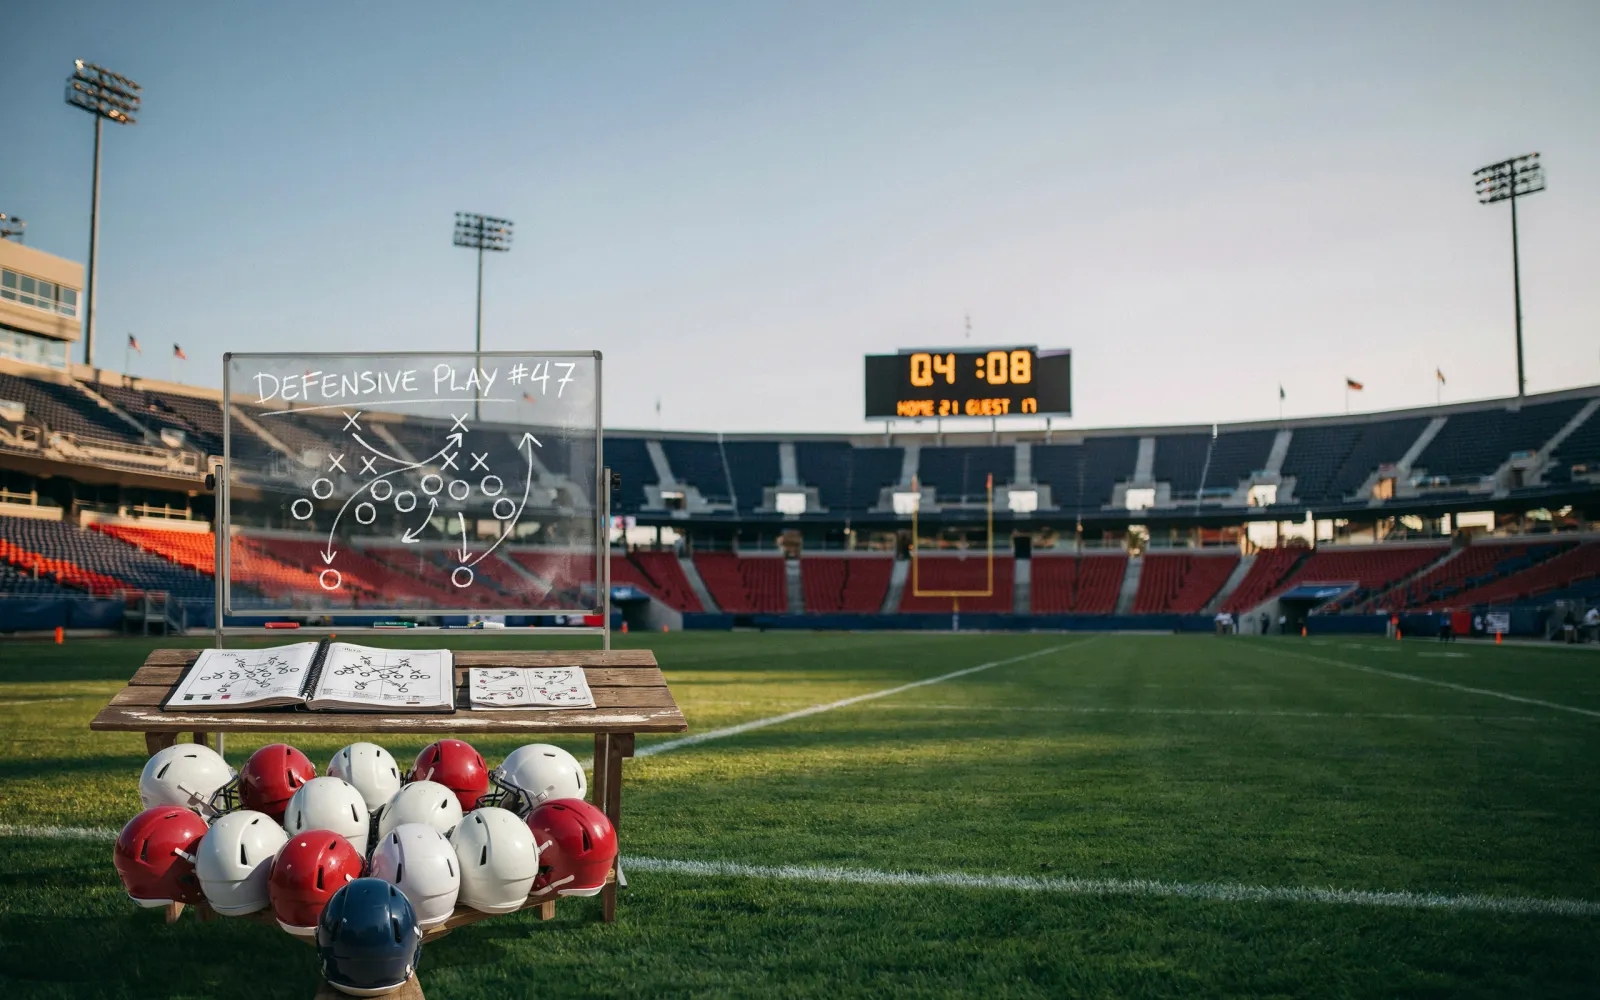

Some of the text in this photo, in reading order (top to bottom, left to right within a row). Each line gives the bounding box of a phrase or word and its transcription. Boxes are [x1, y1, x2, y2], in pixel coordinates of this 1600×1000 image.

[253, 361, 576, 403] DEFENSIVE PLAY #47
[910, 350, 1031, 386] Q4 :08
[897, 400, 934, 416] HOME
[938, 400, 959, 416] 21
[965, 398, 1010, 415] GUEST
